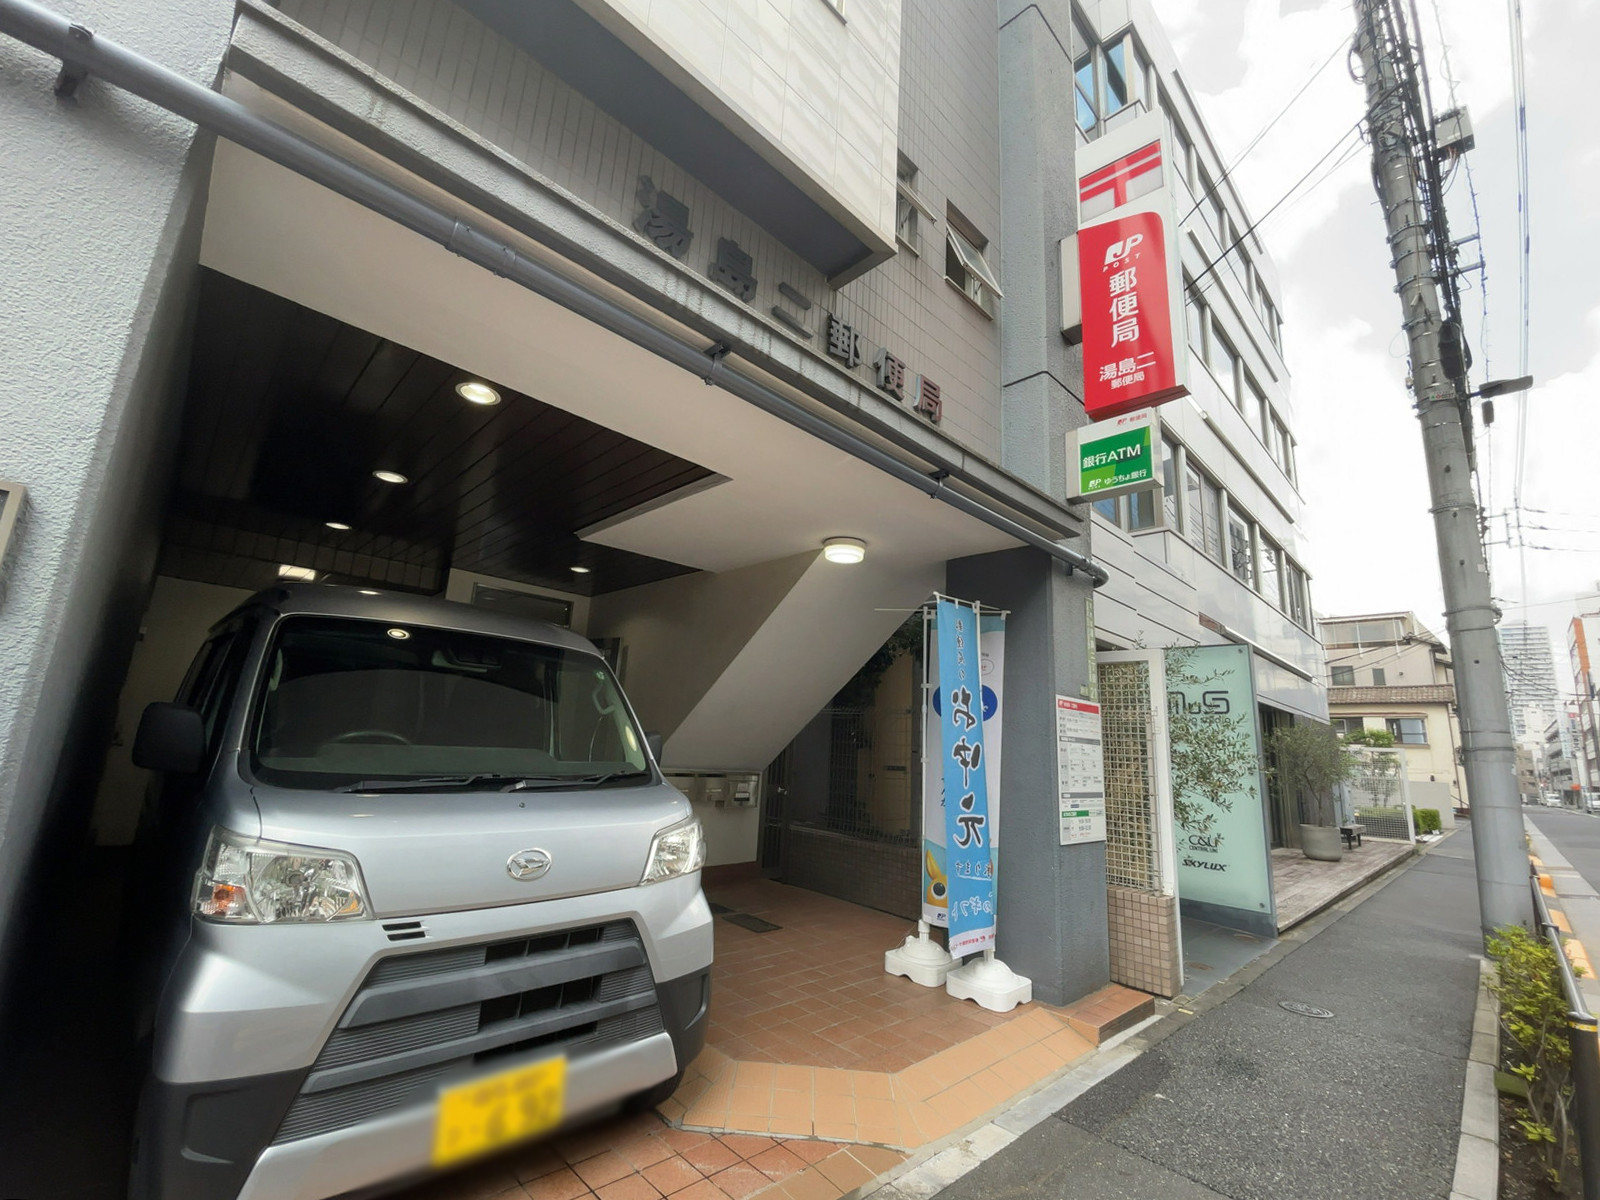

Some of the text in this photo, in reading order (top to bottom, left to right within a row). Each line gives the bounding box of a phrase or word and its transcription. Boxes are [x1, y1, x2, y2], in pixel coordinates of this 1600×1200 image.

[1102, 252, 1142, 272] POST
[632, 174, 944, 424] 湯島二郵便局
[1109, 268, 1141, 349] 郵便局
[1099, 351, 1156, 384] 湯島二
[1111, 372, 1146, 390] 郵便局
[1082, 443, 1141, 469] 銀行ATM
[1104, 468, 1147, 485] ゆうちょ銀行
[1182, 858, 1228, 872] SKYLUX
